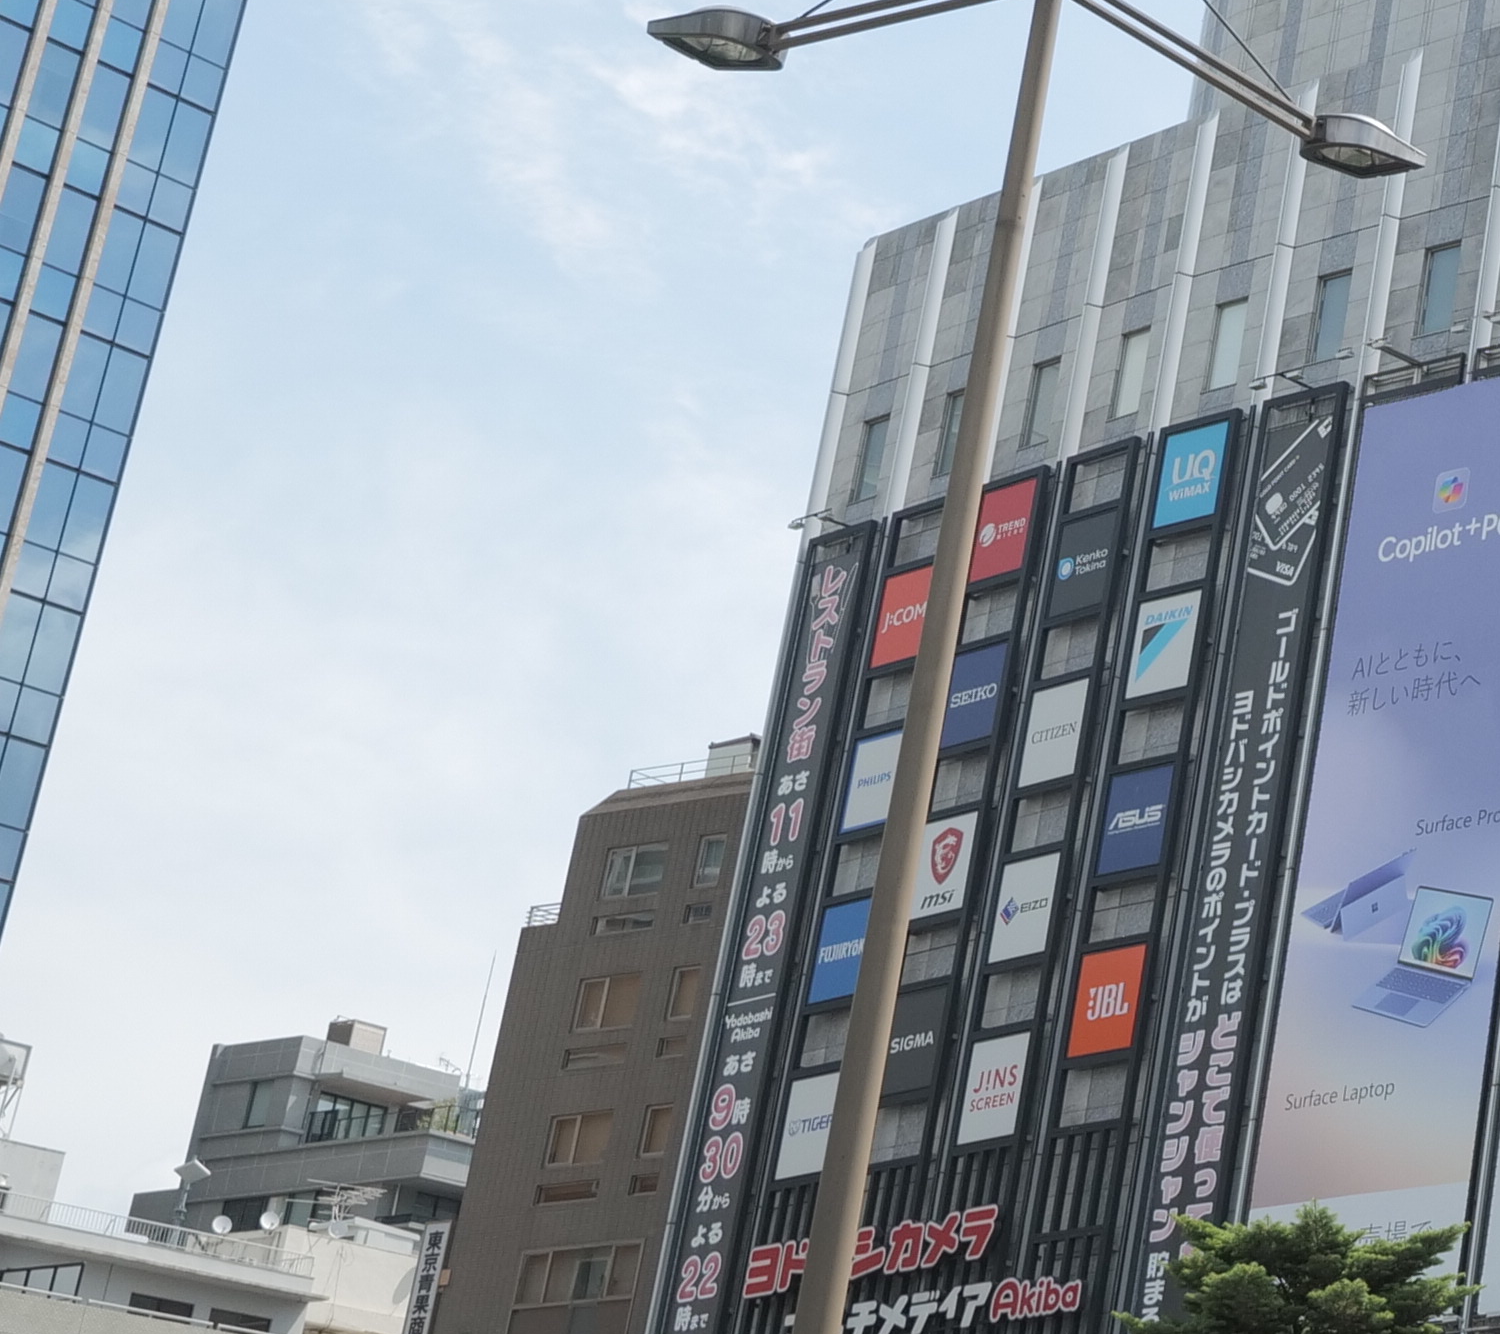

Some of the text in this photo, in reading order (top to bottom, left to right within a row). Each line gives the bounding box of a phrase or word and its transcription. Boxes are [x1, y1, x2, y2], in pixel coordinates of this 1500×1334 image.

[1170, 449, 1216, 485] UQ
[1167, 482, 1211, 502] WiMAX
[996, 517, 1026, 532] TREND
[1074, 559, 1106, 577] Tokina
[1075, 548, 1109, 565] Kenko
[1144, 605, 1193, 625] DAIKIN
[787, 565, 847, 763] レストラン街
[950, 683, 997, 708] SEIKO
[1347, 670, 1482, 716] 新しい時代へ
[1031, 721, 1077, 746] CITIZEN
[857, 771, 892, 789] PHILIPS
[770, 798, 802, 845] 11
[1108, 805, 1163, 832] ASUS
[1415, 811, 1472, 837] Surface
[920, 888, 956, 910] msi
[1019, 896, 1049, 916] EIZO
[742, 910, 786, 960] 23
[1086, 981, 1129, 1021] JBL
[724, 1007, 773, 1030] Yodobashi
[731, 1025, 760, 1043] Akiba
[890, 1030, 934, 1054] SIGMA
[969, 1091, 1015, 1112] SCREEN
[1284, 1080, 1395, 1112] Surface Laptop
[990, 1276, 1081, 1323] Akiba
[674, 1306, 709, 1331] 時まで
